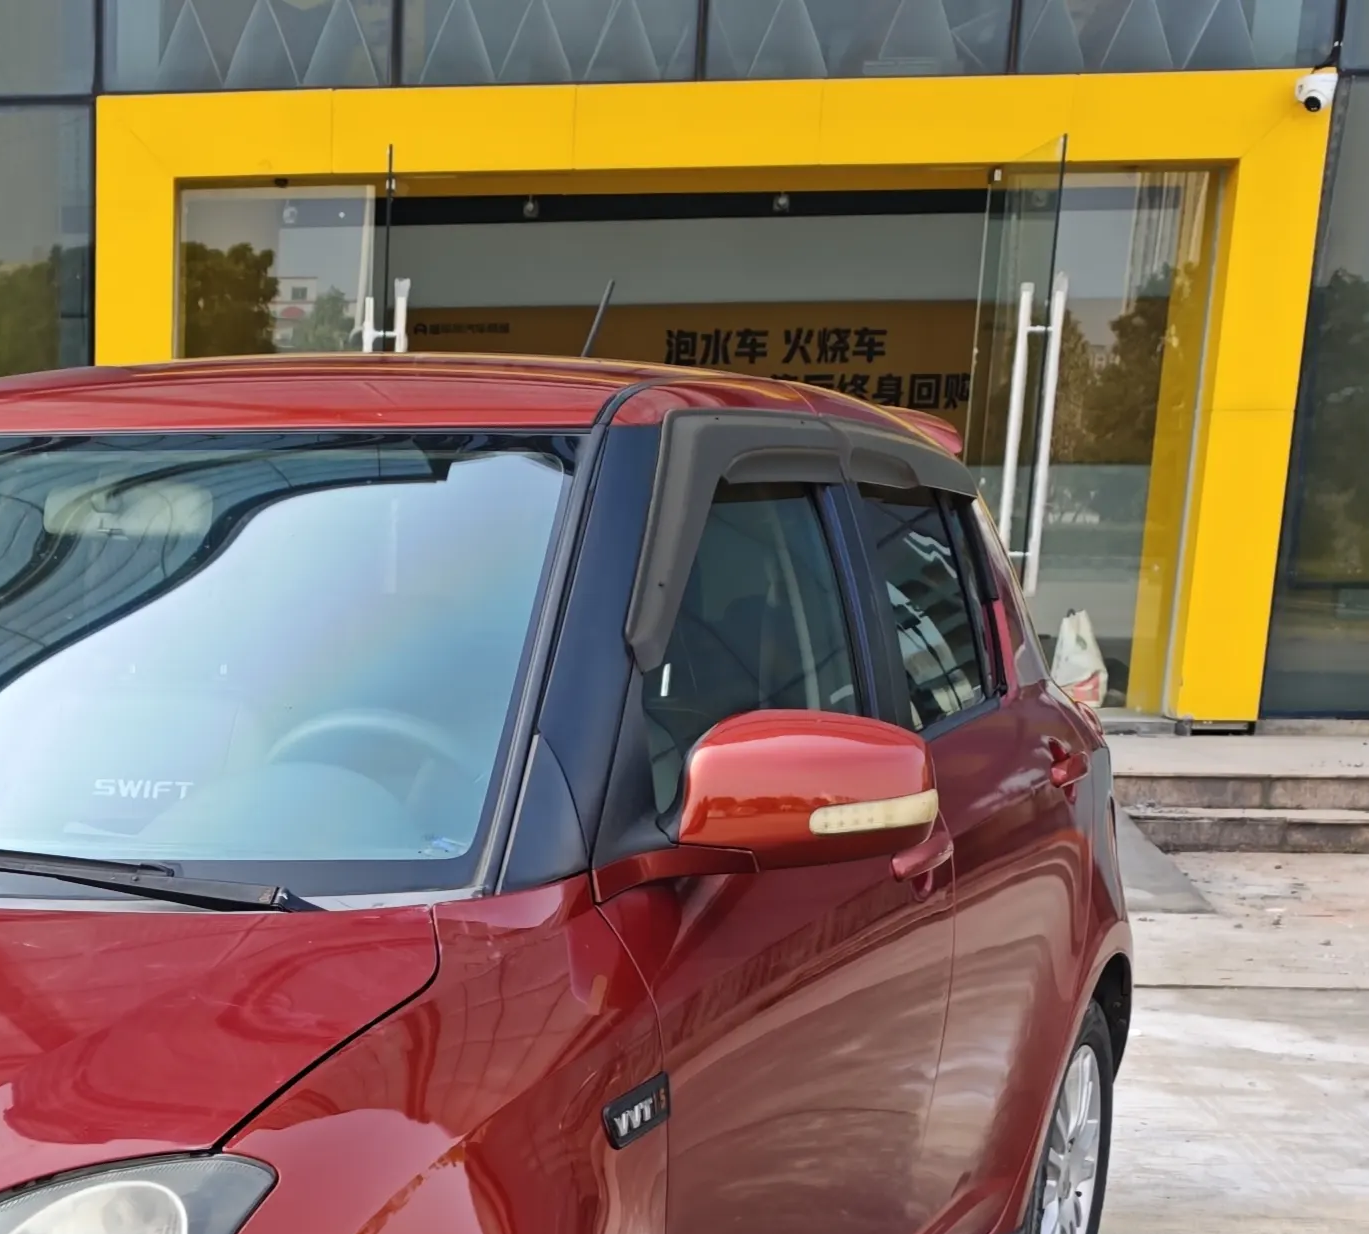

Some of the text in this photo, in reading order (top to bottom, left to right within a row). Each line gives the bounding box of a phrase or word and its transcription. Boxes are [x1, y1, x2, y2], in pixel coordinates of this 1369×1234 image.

[664, 327, 887, 365] 泡水车 火烧车
[770, 374, 971, 410] 终身回购
[92, 778, 194, 800] SWIFT
